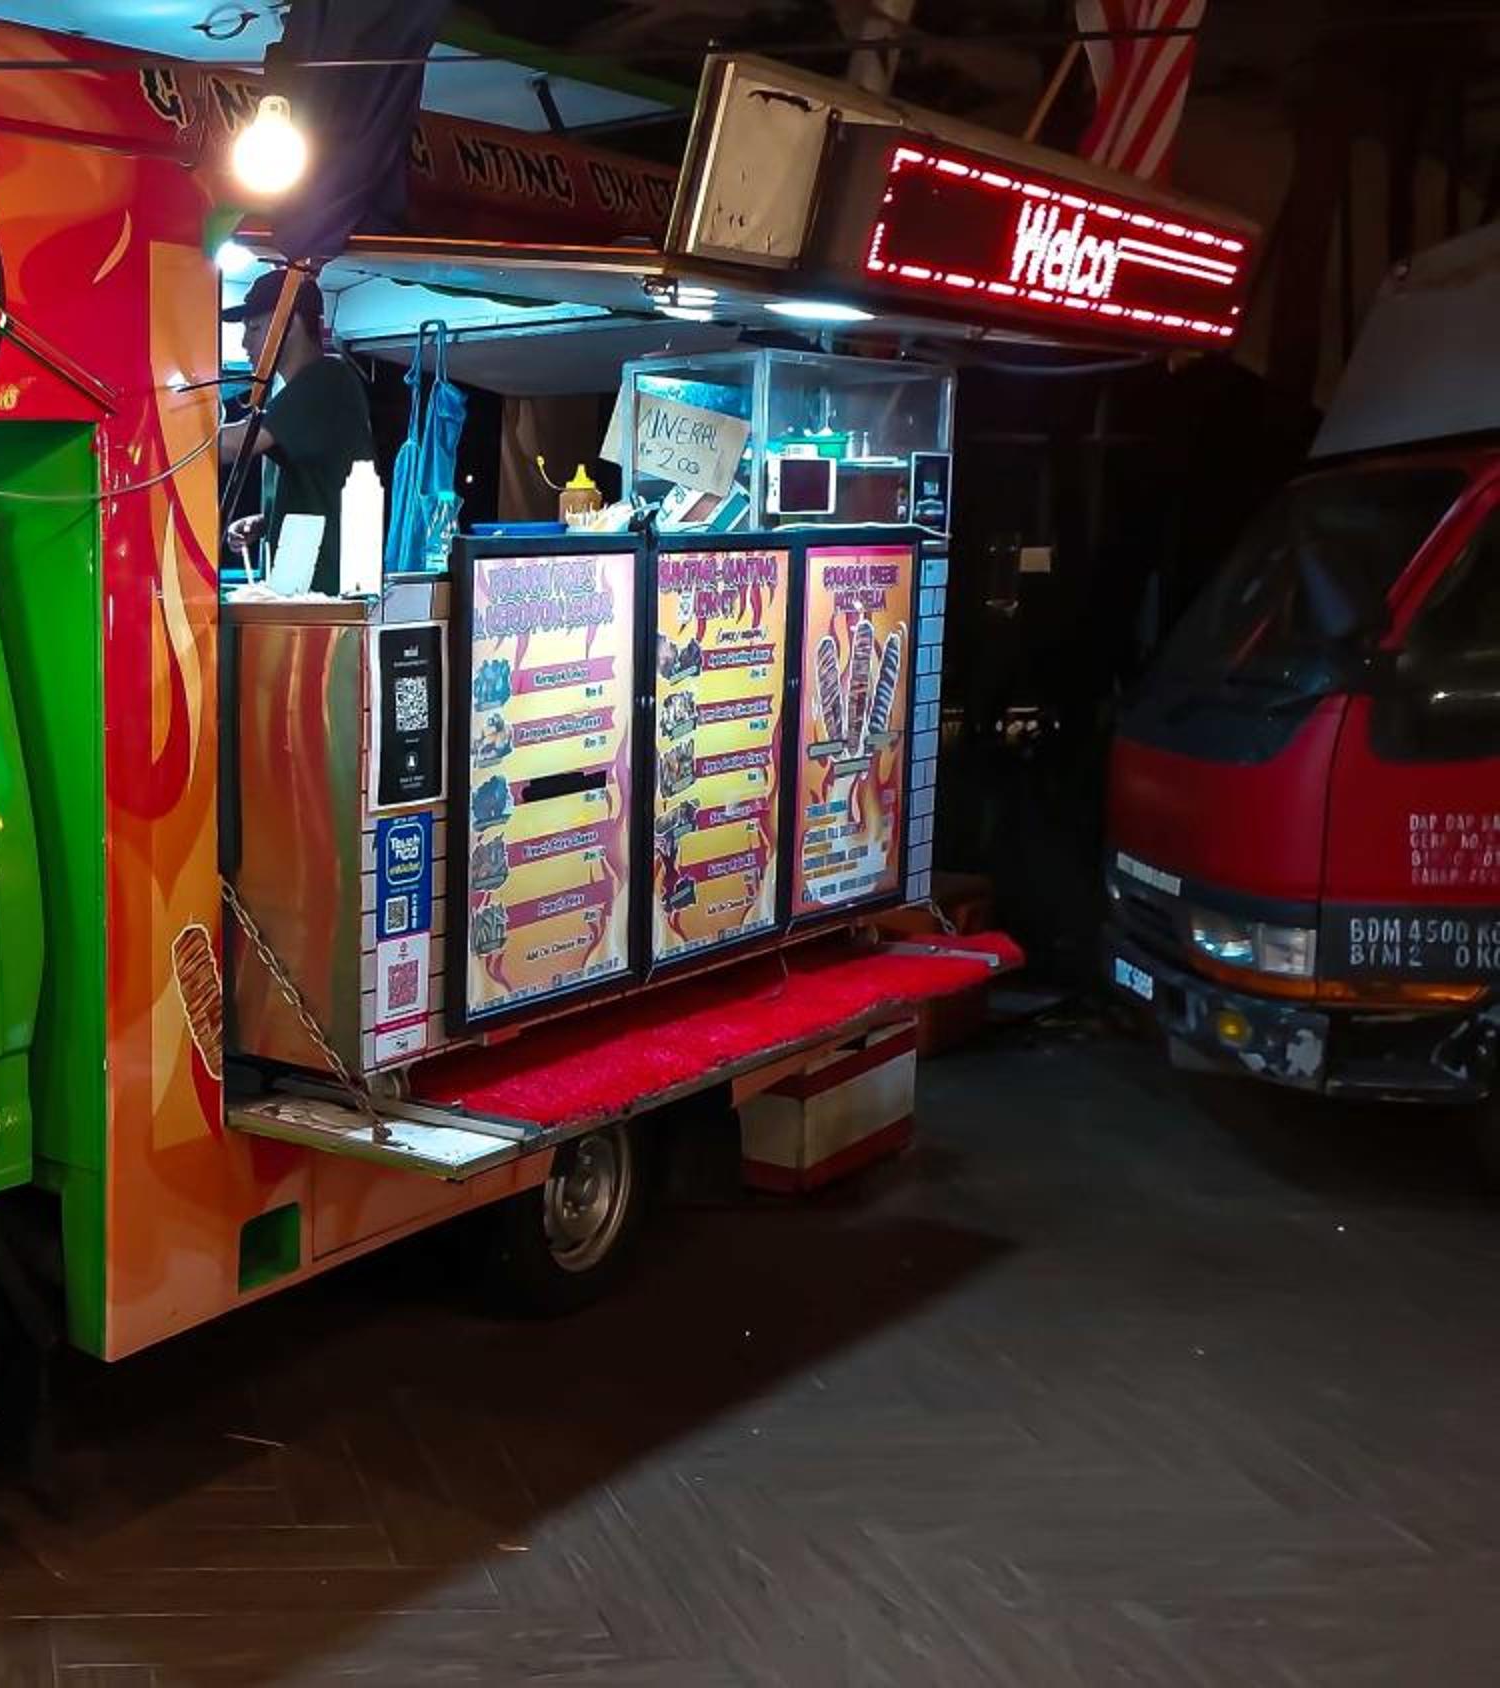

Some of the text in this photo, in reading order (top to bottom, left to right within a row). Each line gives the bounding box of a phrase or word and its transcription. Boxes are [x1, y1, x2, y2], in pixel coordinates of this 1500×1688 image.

[1350, 917, 1401, 944] BDM
[1408, 918, 1470, 944] 4500
[1408, 944, 1470, 968] 20
